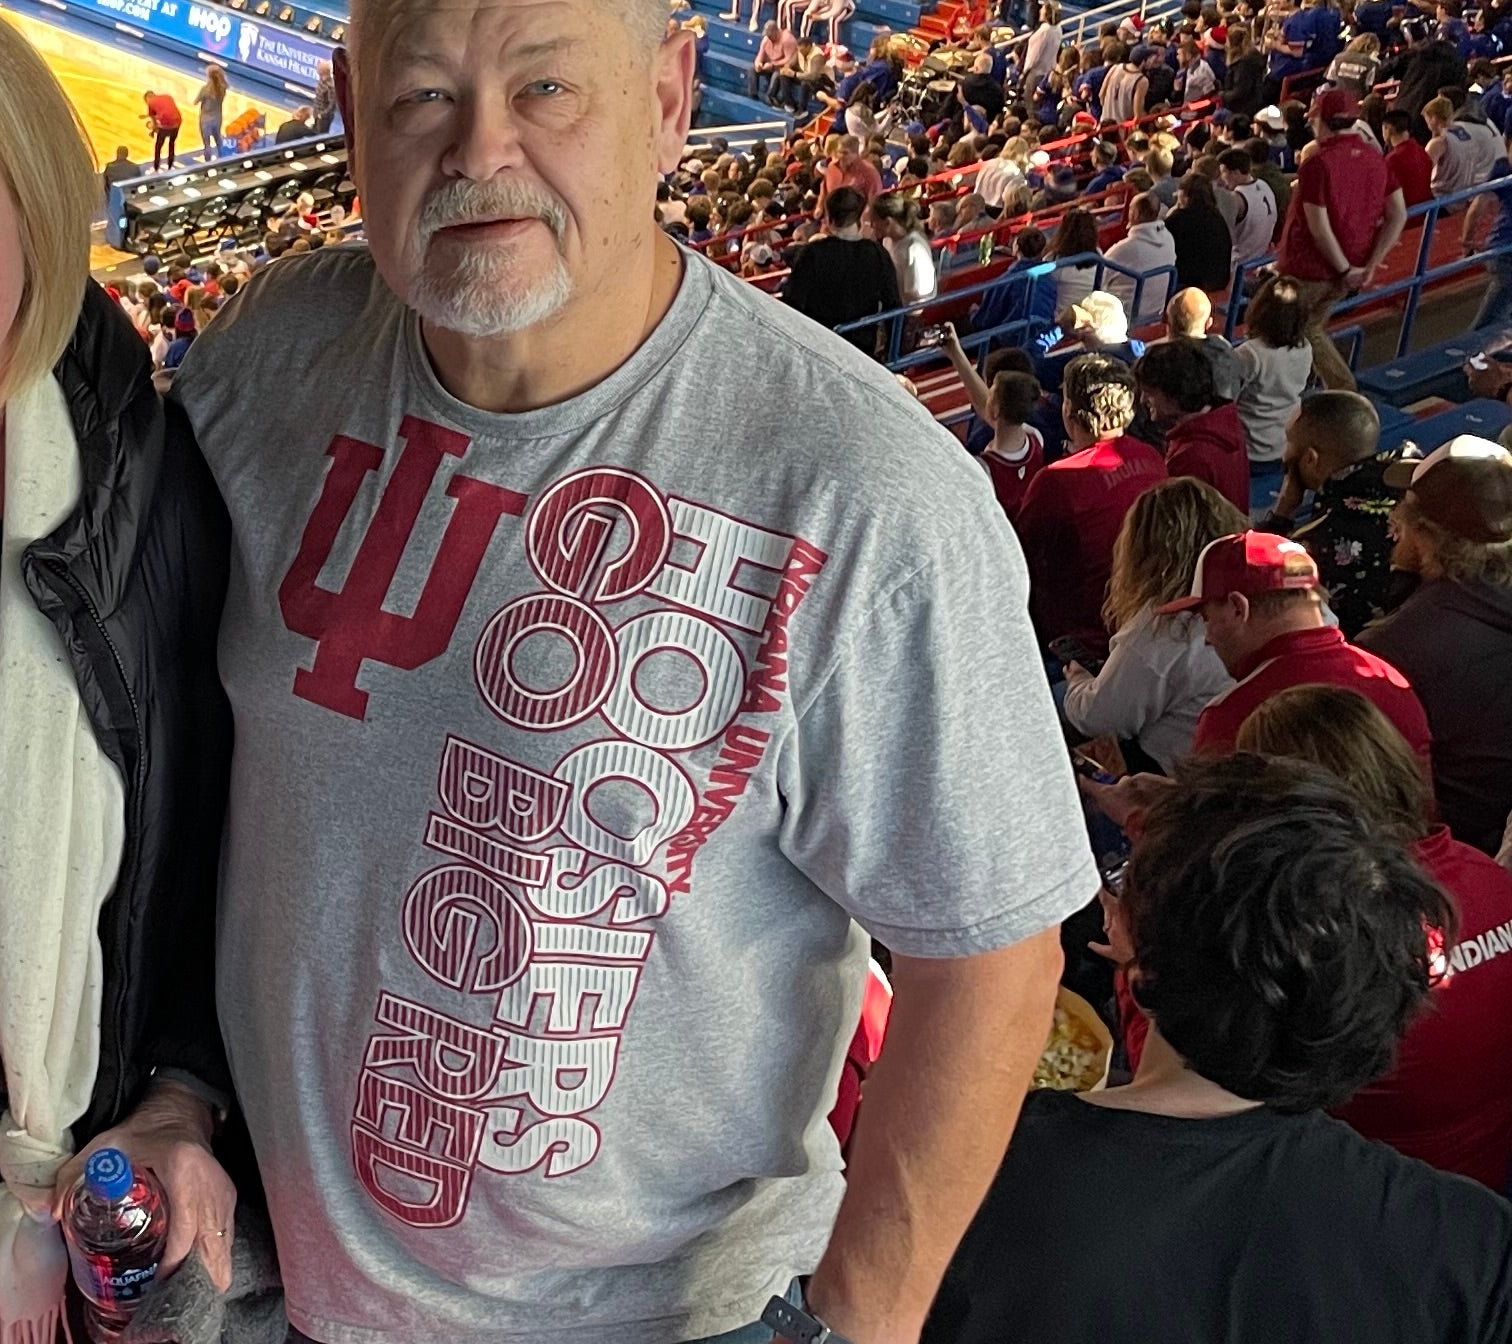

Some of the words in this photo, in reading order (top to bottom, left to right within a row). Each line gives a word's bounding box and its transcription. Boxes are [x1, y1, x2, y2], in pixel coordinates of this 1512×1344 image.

[160, 2, 179, 17] AT
[188, 5, 231, 42] IHOP
[259, 35, 276, 51] THE
[1262, 196, 1272, 216] 1
[475, 464, 674, 732] GO
[742, 536, 830, 723] INDIANA
[400, 734, 574, 994] BIG
[476, 494, 800, 1180] HOOSIERS
[667, 725, 770, 896] UNIVERSITY
[351, 988, 509, 1231] RED
